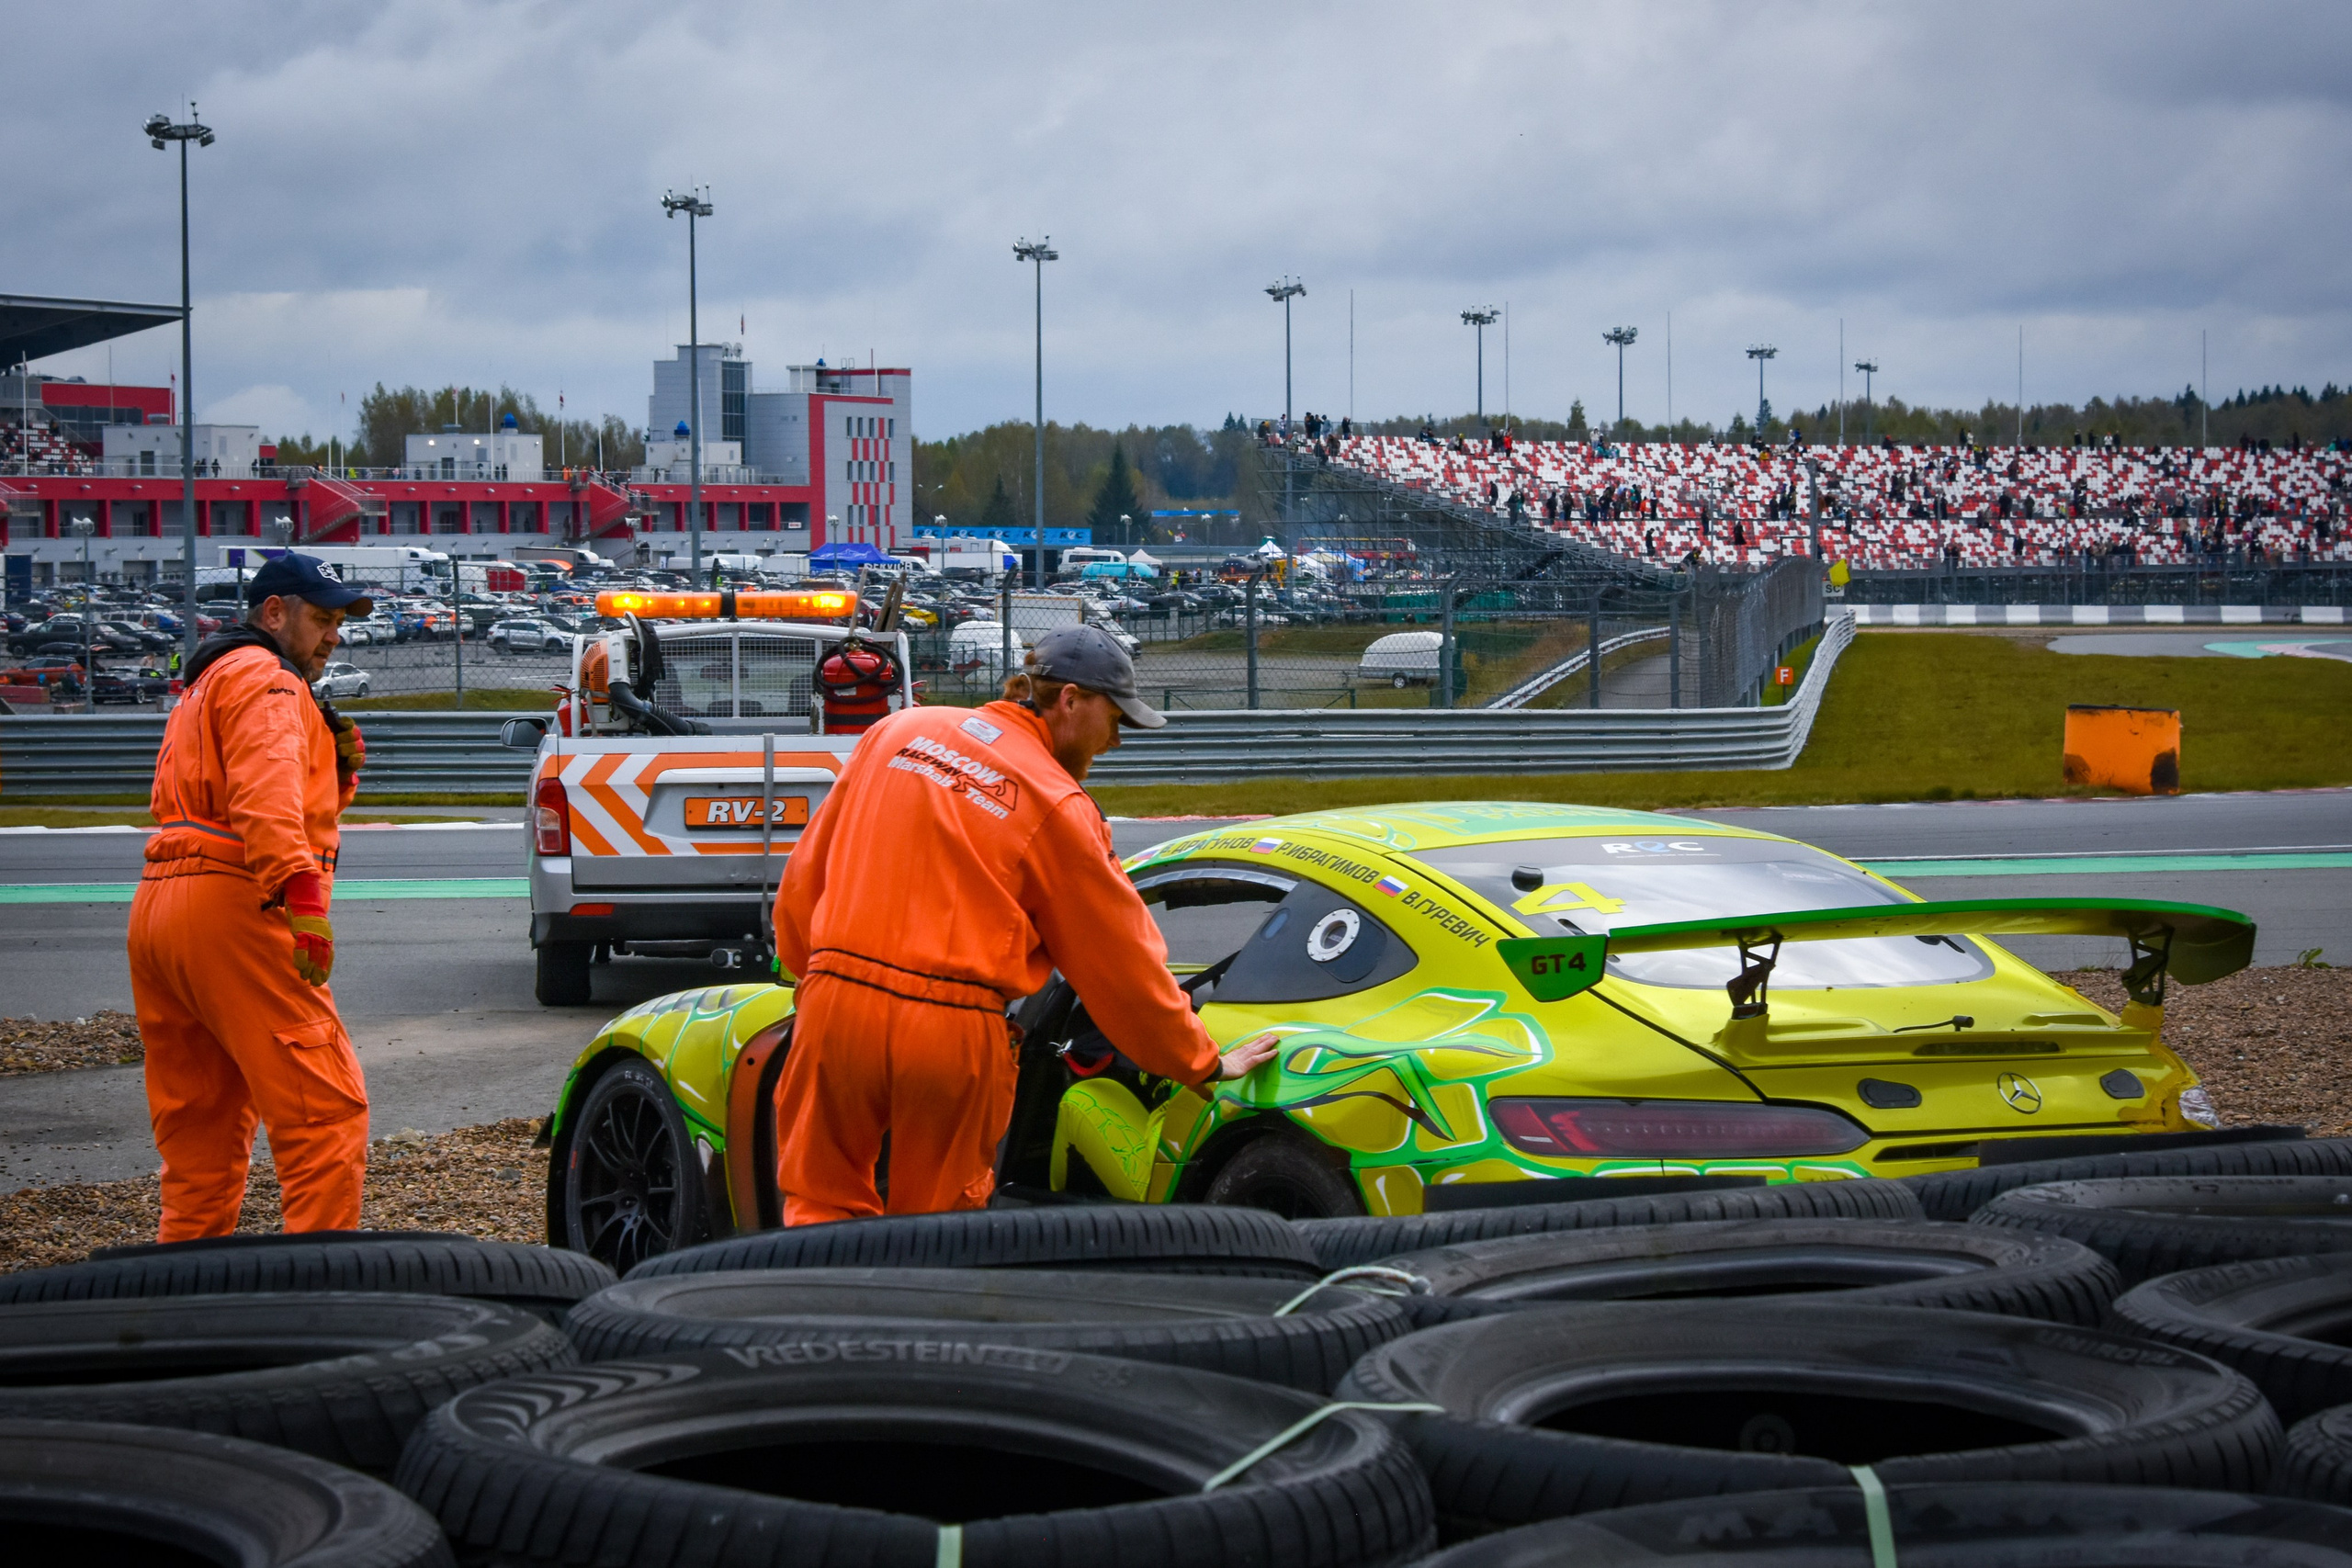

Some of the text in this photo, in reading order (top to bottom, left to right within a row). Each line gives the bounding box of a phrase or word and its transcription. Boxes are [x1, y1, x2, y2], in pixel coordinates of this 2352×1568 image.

[1780, 669, 1789, 682] F
[895, 748, 962, 776] RACEWAY
[905, 736, 1006, 784] MOSCOW
[887, 756, 1009, 819] Marshals Team
[707, 800, 786, 823] RV-2
[1510, 882, 1627, 916] 4
[1401, 890, 1491, 949] В.ГУРЕВИЧ
[722, 1340, 987, 1370] VREDESTEIN
